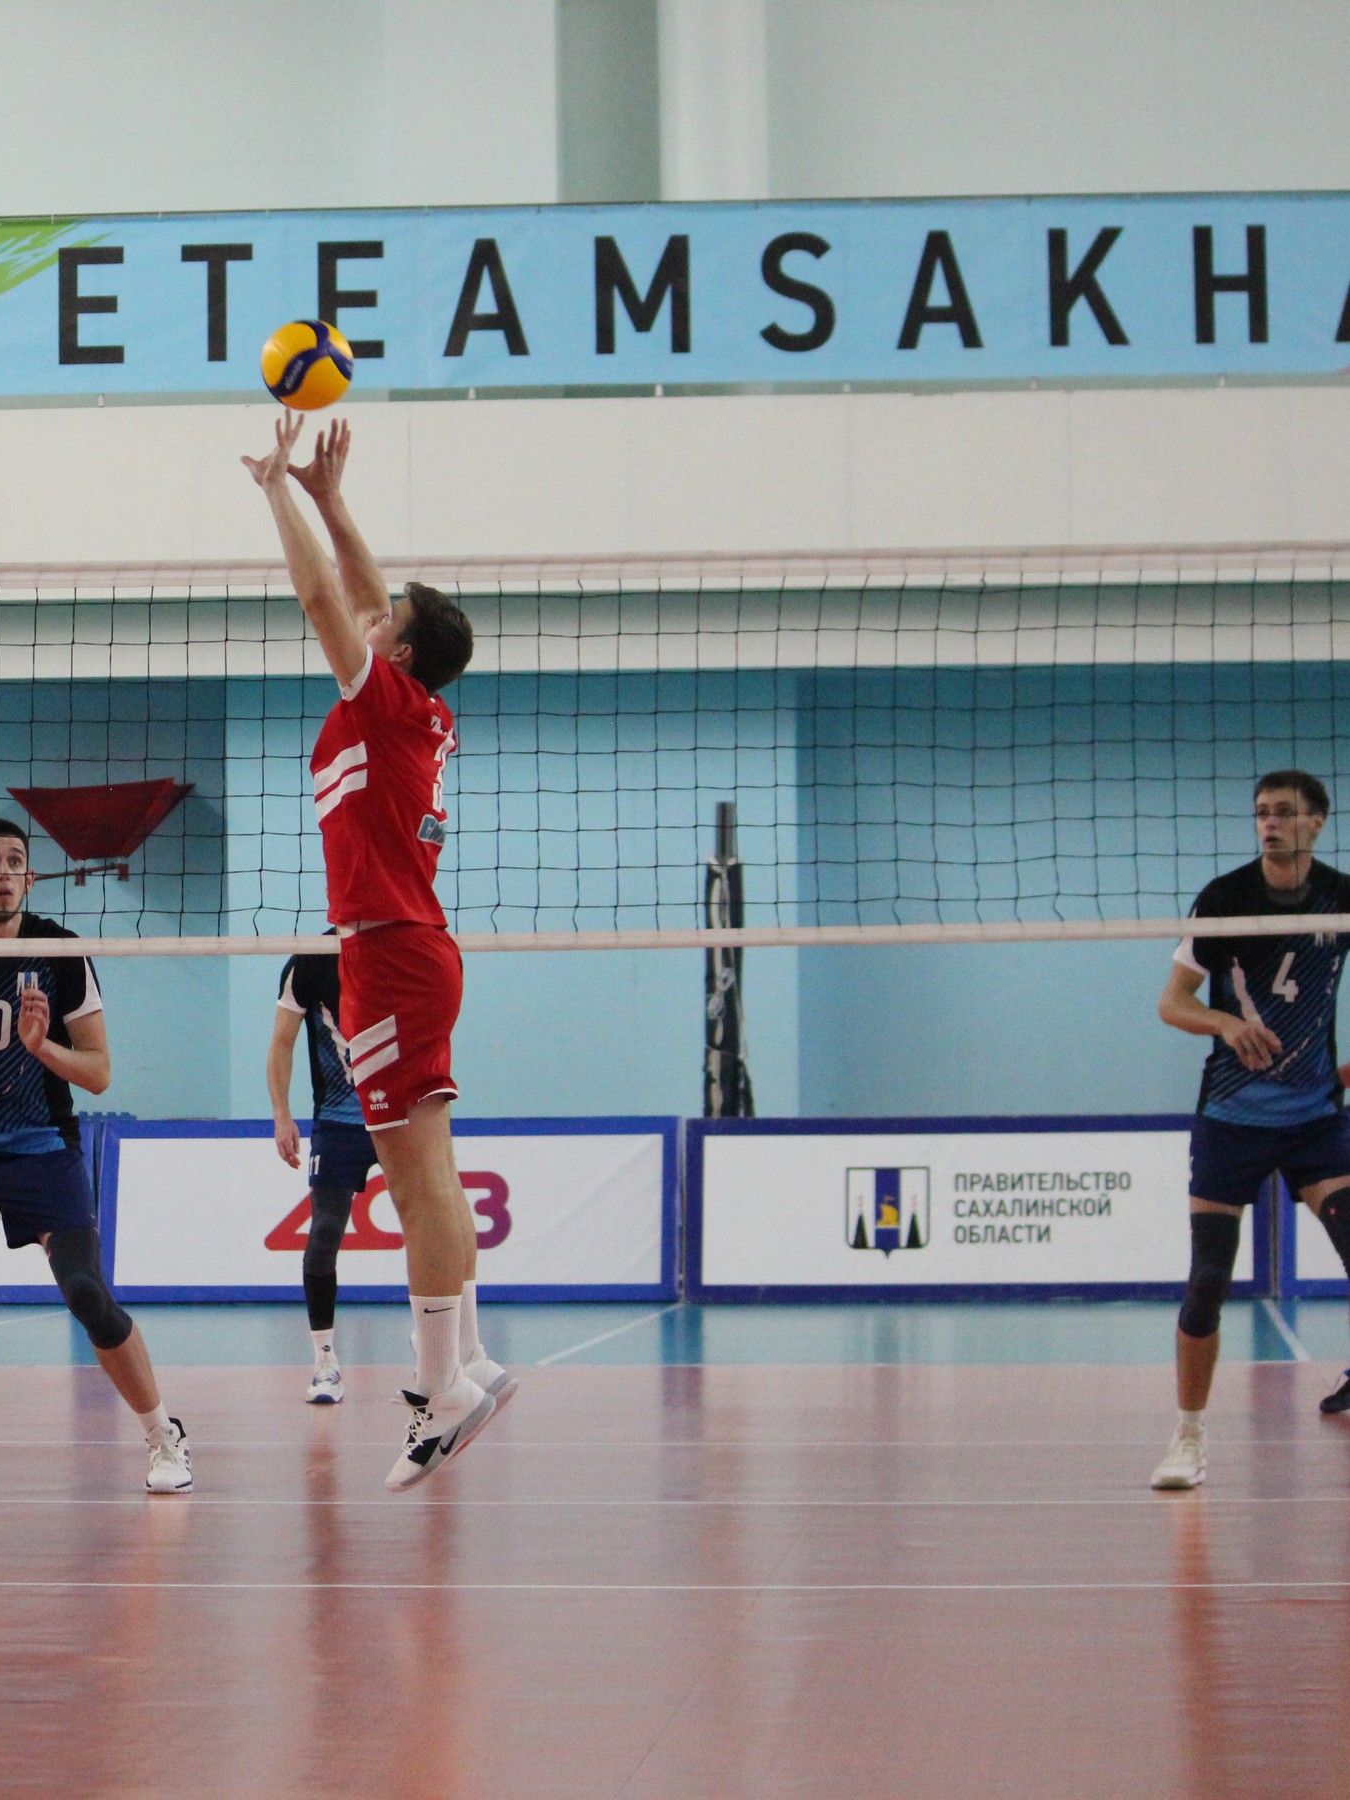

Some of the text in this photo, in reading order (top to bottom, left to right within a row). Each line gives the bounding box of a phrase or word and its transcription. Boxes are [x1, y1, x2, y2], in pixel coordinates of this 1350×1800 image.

[1272, 951, 1299, 1003] 4
[954, 1171, 1131, 1192] ПРАВИТЕЛЬСТВО
[954, 1193, 1112, 1217] САХАЛИНСКОЙ
[954, 1224, 1052, 1244] ОБЛАСТИ
